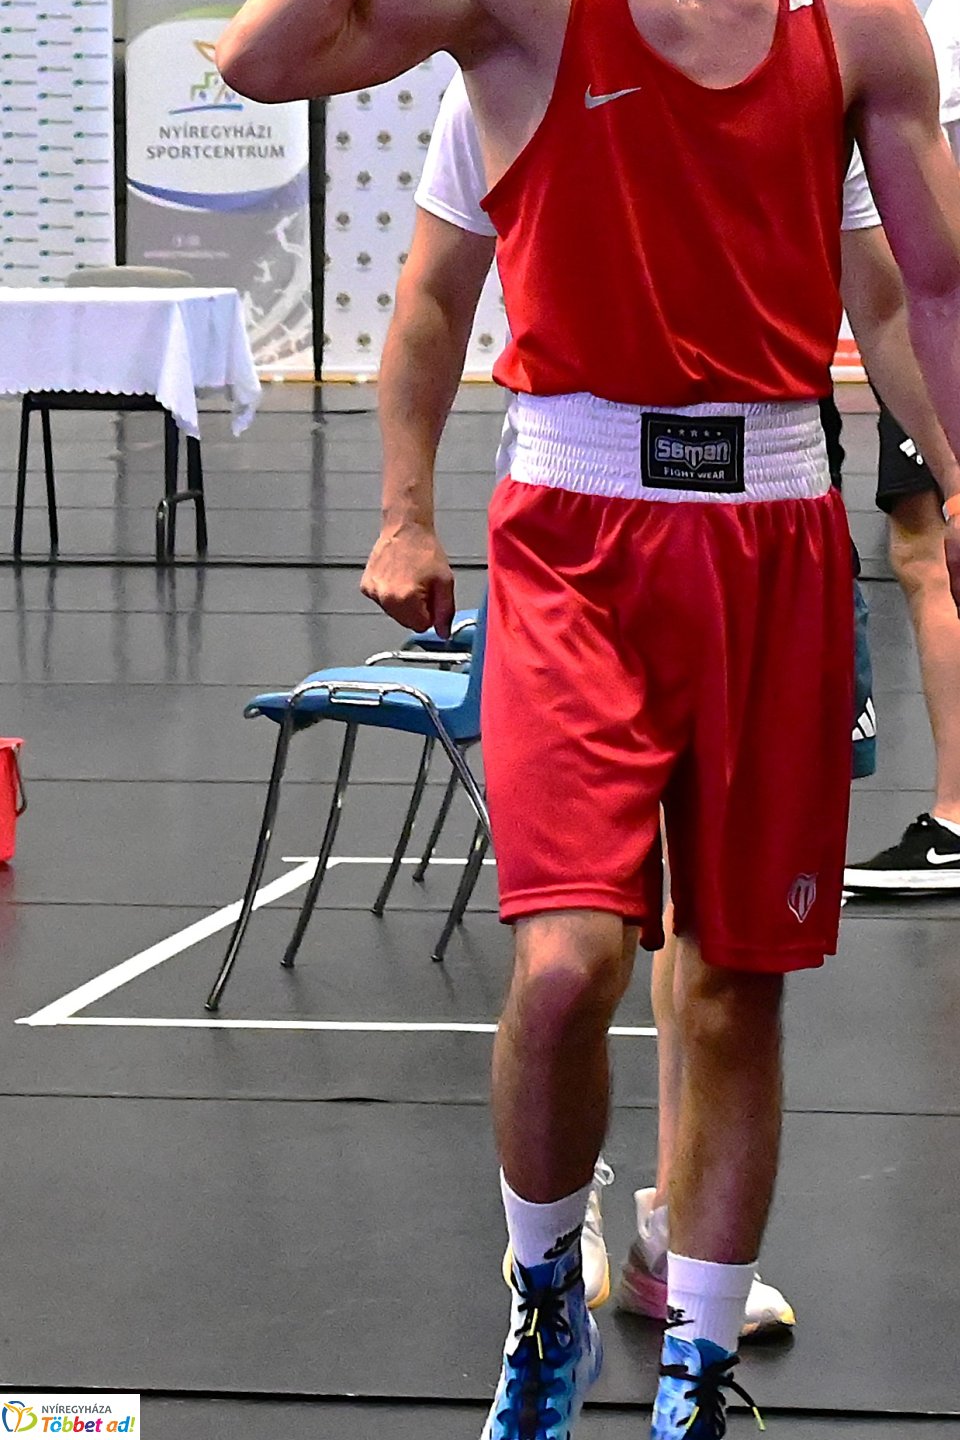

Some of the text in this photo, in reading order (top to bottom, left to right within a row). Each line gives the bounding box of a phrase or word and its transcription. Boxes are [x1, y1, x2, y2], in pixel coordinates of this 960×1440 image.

[159, 122, 272, 139] NYÍREGYHÁZI
[146, 145, 285, 160] SPORTCENTRUM
[663, 466, 725, 480] FIGHT WEAR
